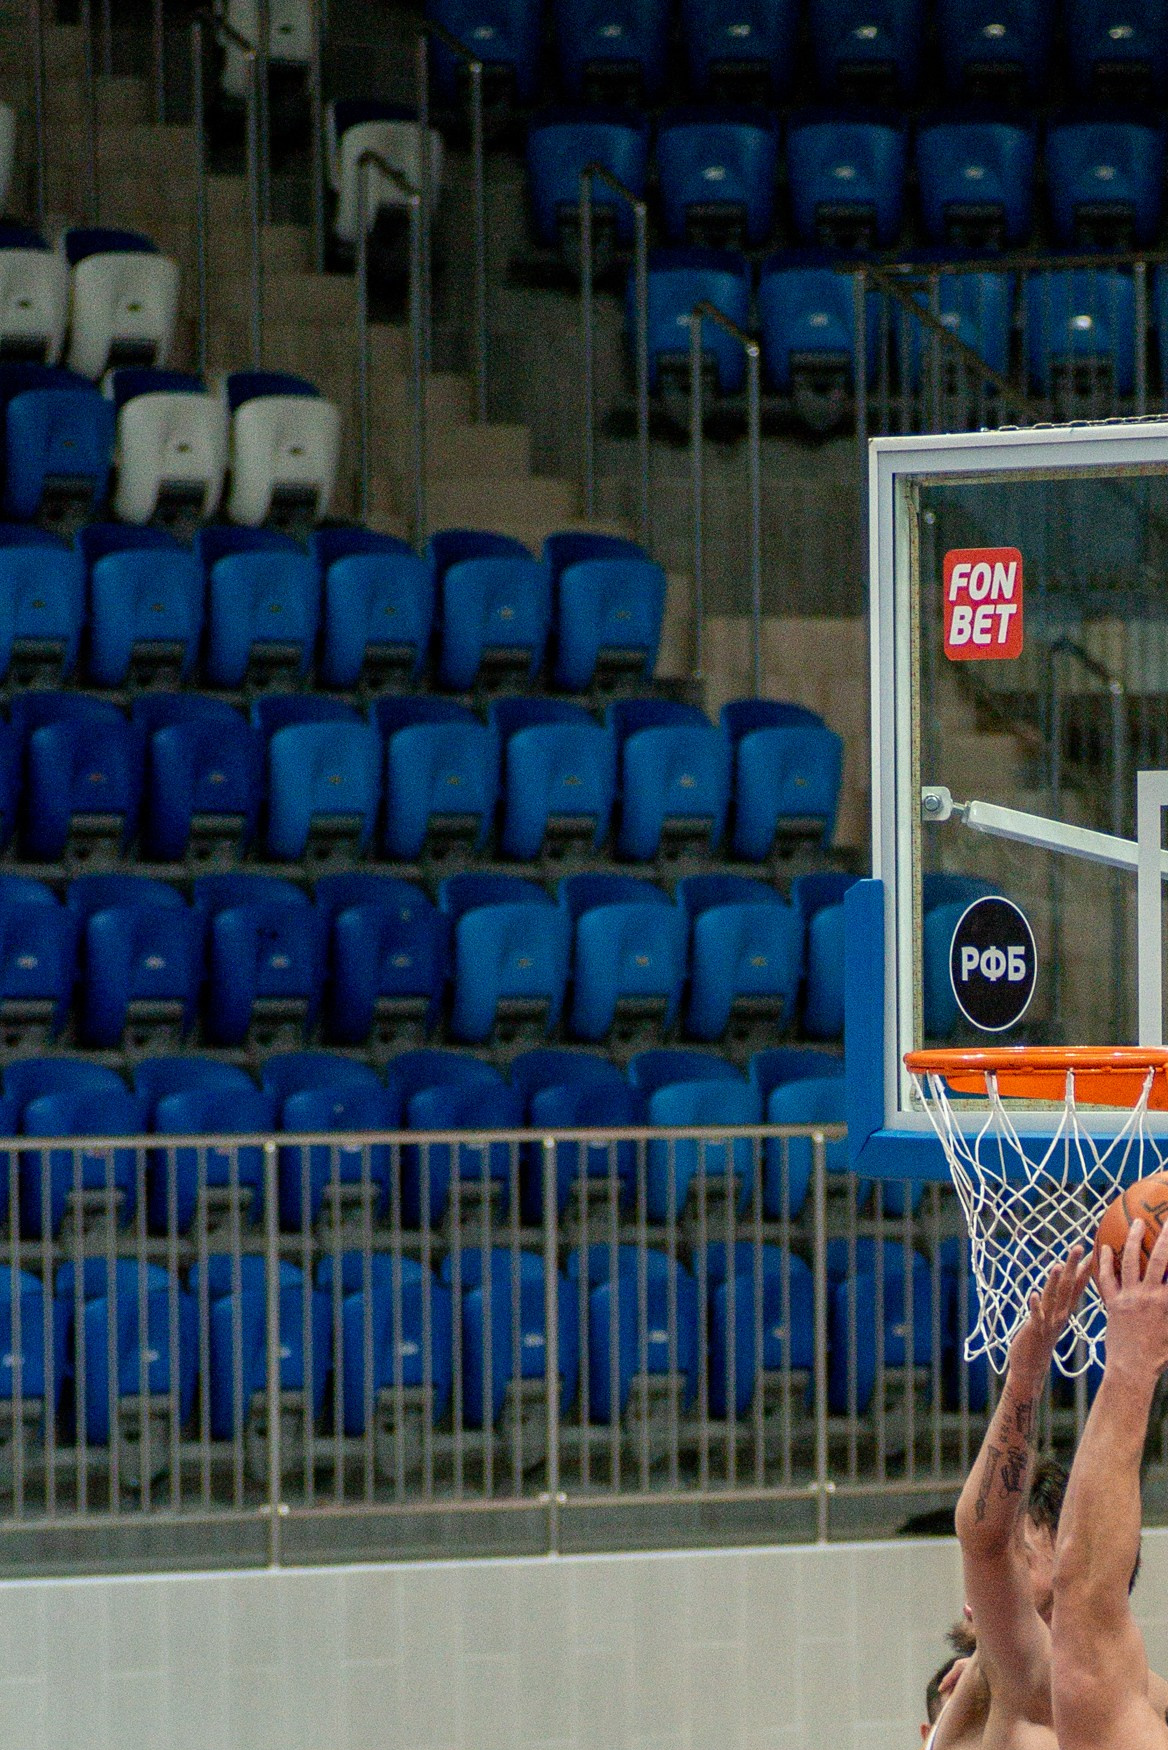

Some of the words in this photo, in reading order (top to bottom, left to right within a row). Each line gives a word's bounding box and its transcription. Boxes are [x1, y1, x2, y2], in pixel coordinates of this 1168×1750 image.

[948, 561, 1018, 601] FON
[948, 603, 1018, 645] BET
[961, 945, 1026, 981] РФБ
